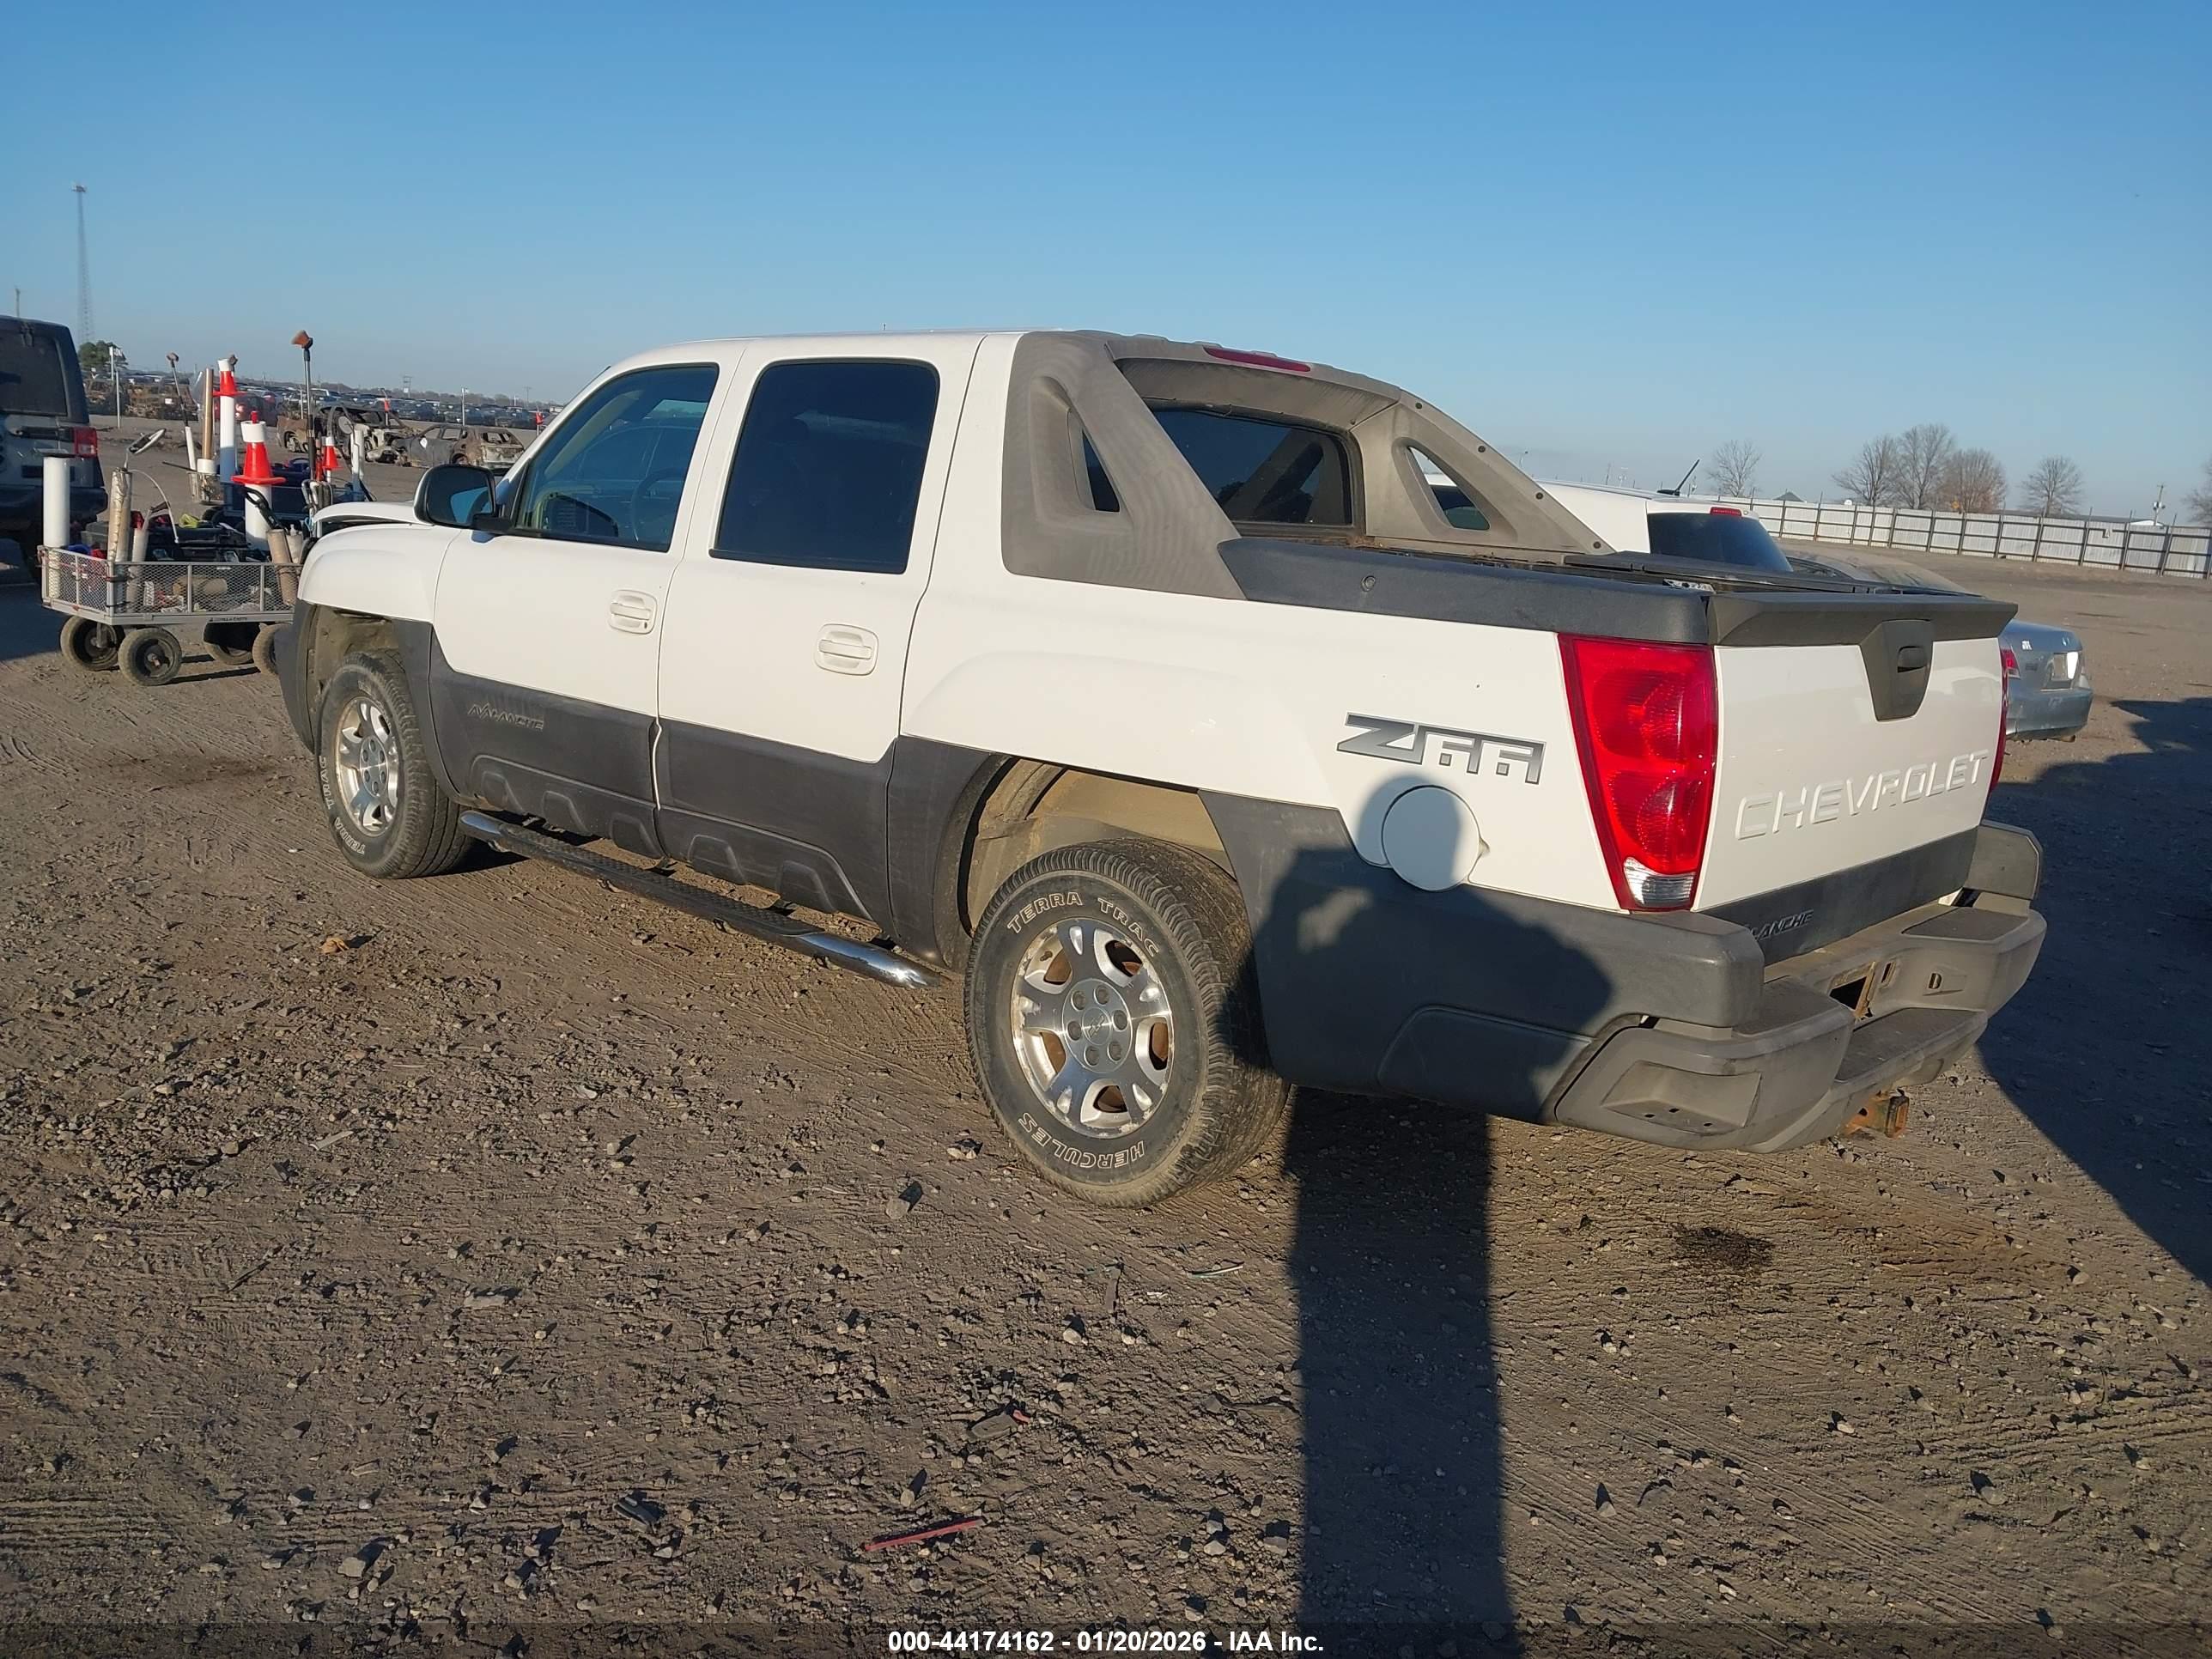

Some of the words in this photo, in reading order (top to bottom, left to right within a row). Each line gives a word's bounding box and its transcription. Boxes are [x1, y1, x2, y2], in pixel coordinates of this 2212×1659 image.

[467, 702, 544, 730] AVALANCHE
[1735, 749, 1989, 841] CHEVROLET
[1007, 892, 1083, 934] TERRA
[1097, 897, 1159, 957] TRAC
[1018, 1112, 1146, 1169] HERCULES
